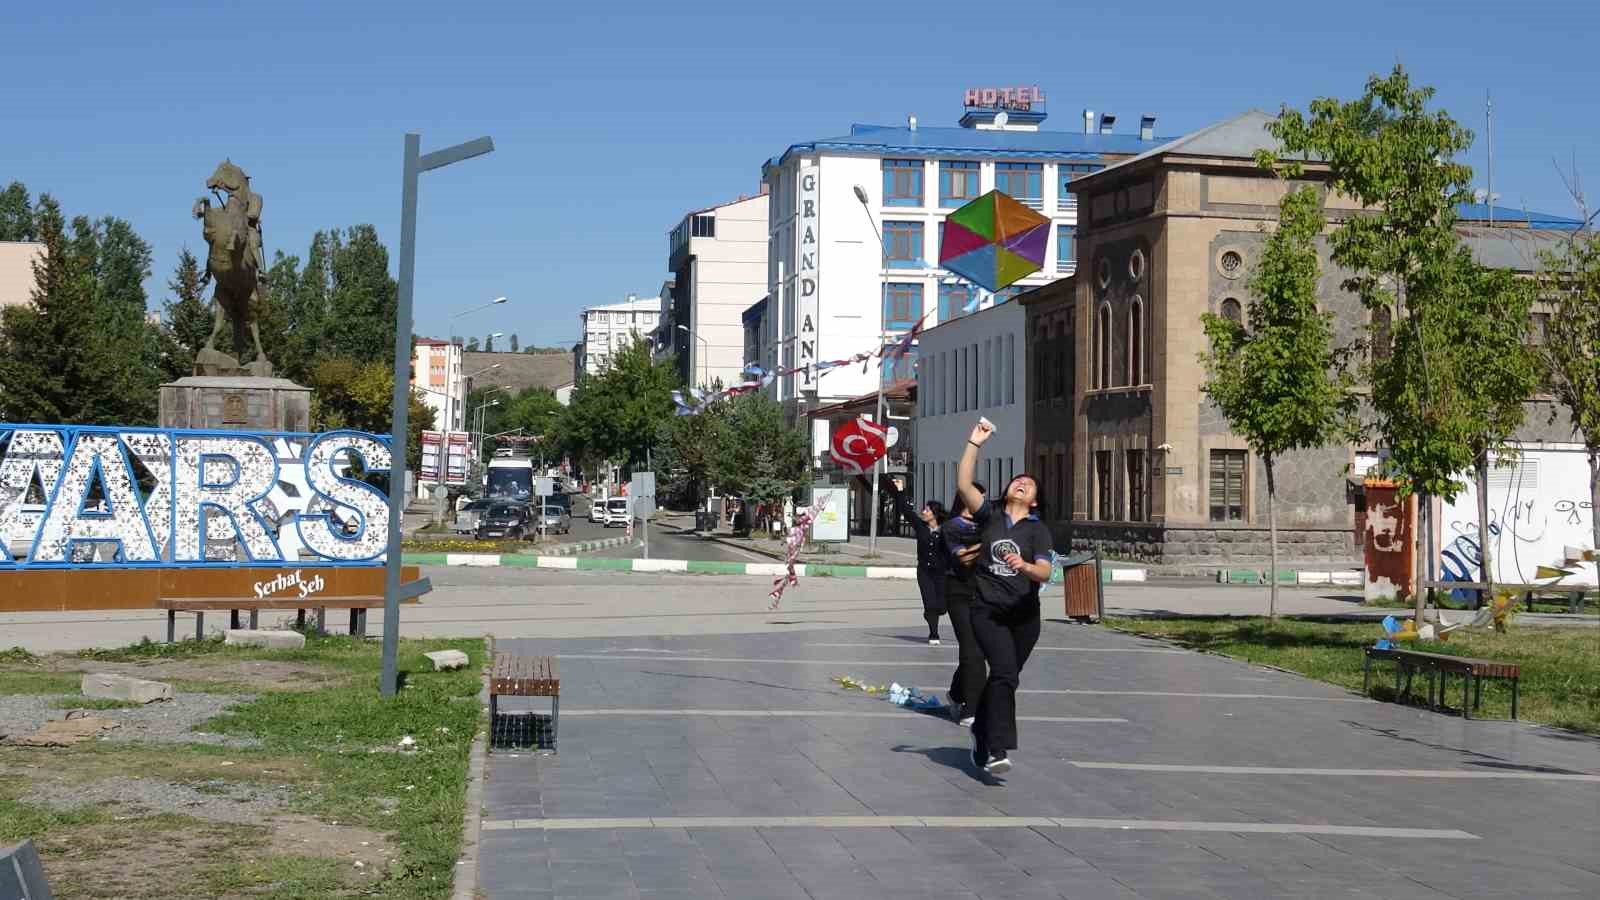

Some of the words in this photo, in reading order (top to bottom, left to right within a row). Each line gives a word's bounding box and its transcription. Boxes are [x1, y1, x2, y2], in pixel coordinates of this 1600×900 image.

[965, 86, 1045, 105] HOTEL
[802, 174, 816, 297] GRAND
[0, 427, 391, 563] ARS
[254, 568, 302, 599] Serhat
